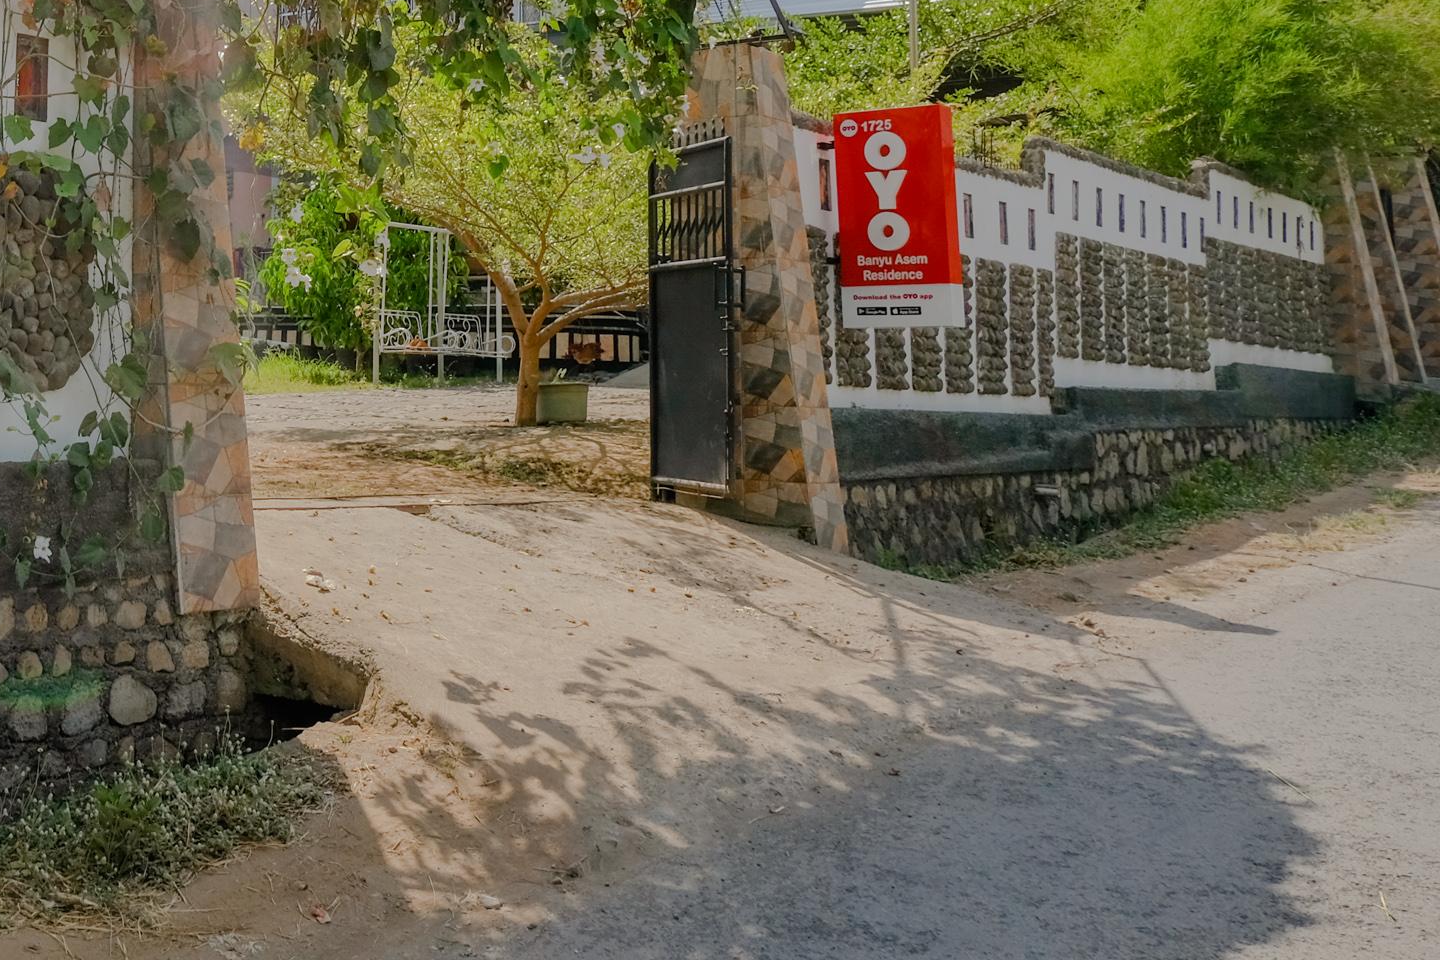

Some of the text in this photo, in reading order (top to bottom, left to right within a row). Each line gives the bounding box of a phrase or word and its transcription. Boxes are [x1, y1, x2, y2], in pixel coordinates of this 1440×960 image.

[861, 119, 892, 132] 1725
[864, 131, 911, 251] OYO
[857, 253, 928, 266] Banyu Asem
[863, 269, 922, 281] Residence
